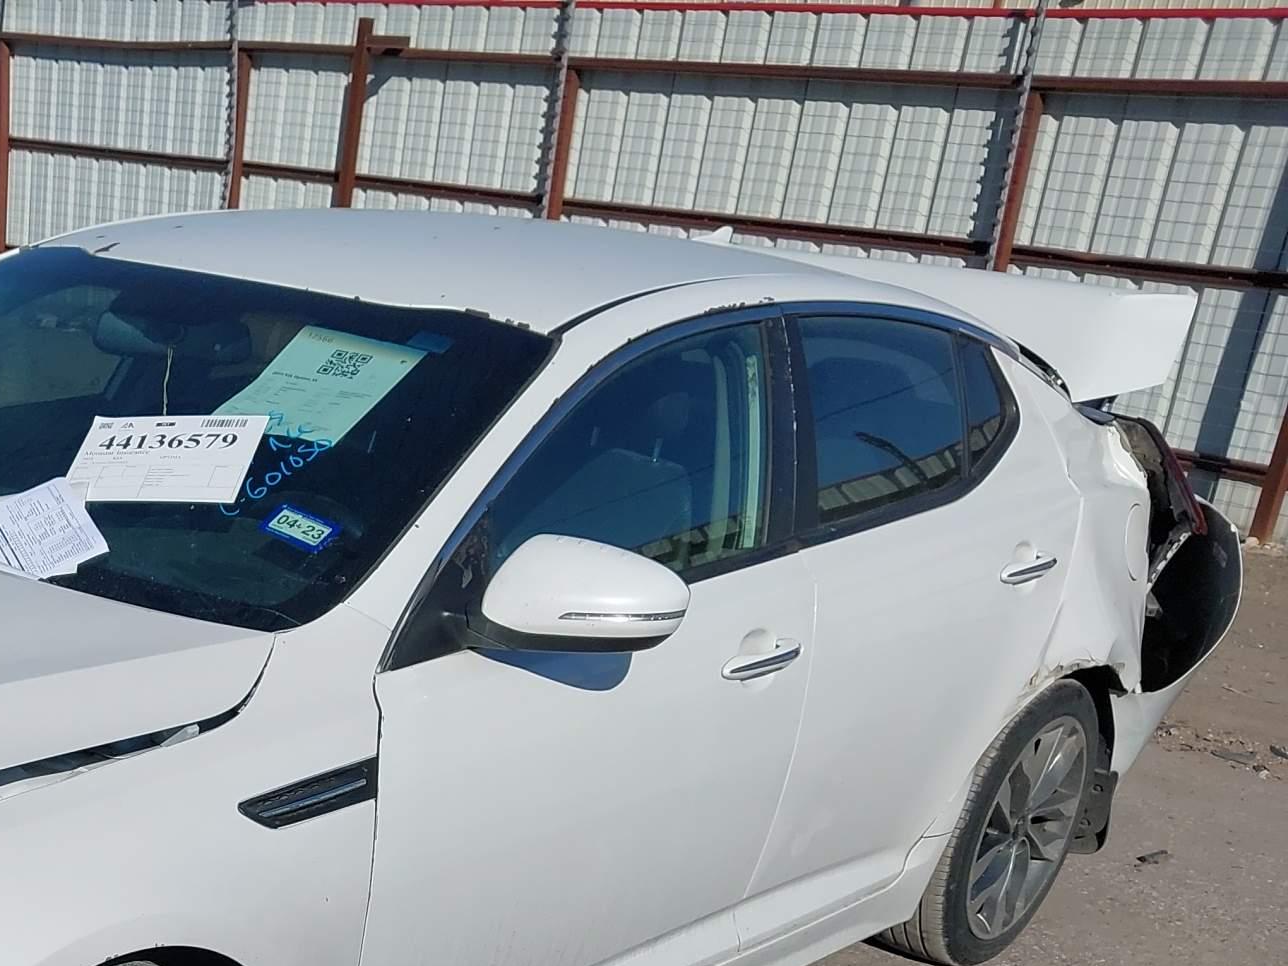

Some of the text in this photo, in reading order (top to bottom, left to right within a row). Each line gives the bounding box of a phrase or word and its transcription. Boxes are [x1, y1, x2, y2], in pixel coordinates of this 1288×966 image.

[98, 432, 238, 450] 44136579
[276, 514, 299, 529] 04
[301, 525, 325, 540] 23
